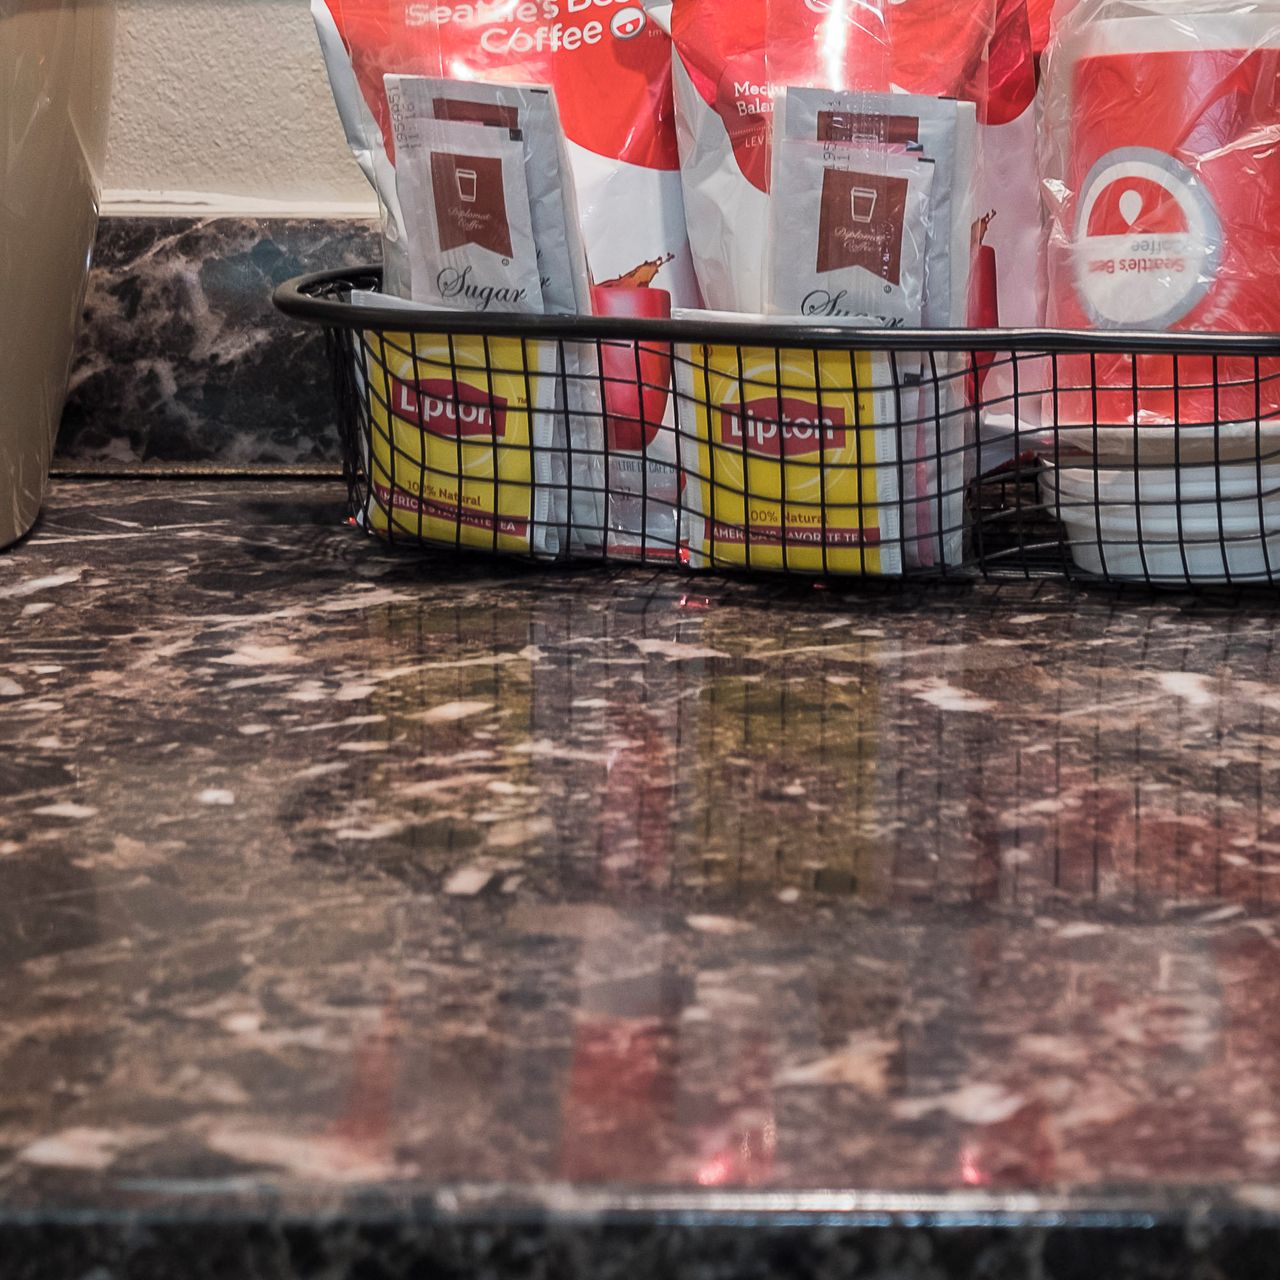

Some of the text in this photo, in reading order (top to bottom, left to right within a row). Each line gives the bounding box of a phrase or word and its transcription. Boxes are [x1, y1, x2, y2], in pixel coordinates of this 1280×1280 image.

[480, 20, 603, 53] Coffee
[735, 97, 775, 116] Bala
[745, 135, 766, 148] LEV
[436, 265, 527, 312] Sugar
[400, 384, 496, 426] Lpton
[730, 409, 835, 446] Lipton
[748, 510, 828, 525] 00% Natura
